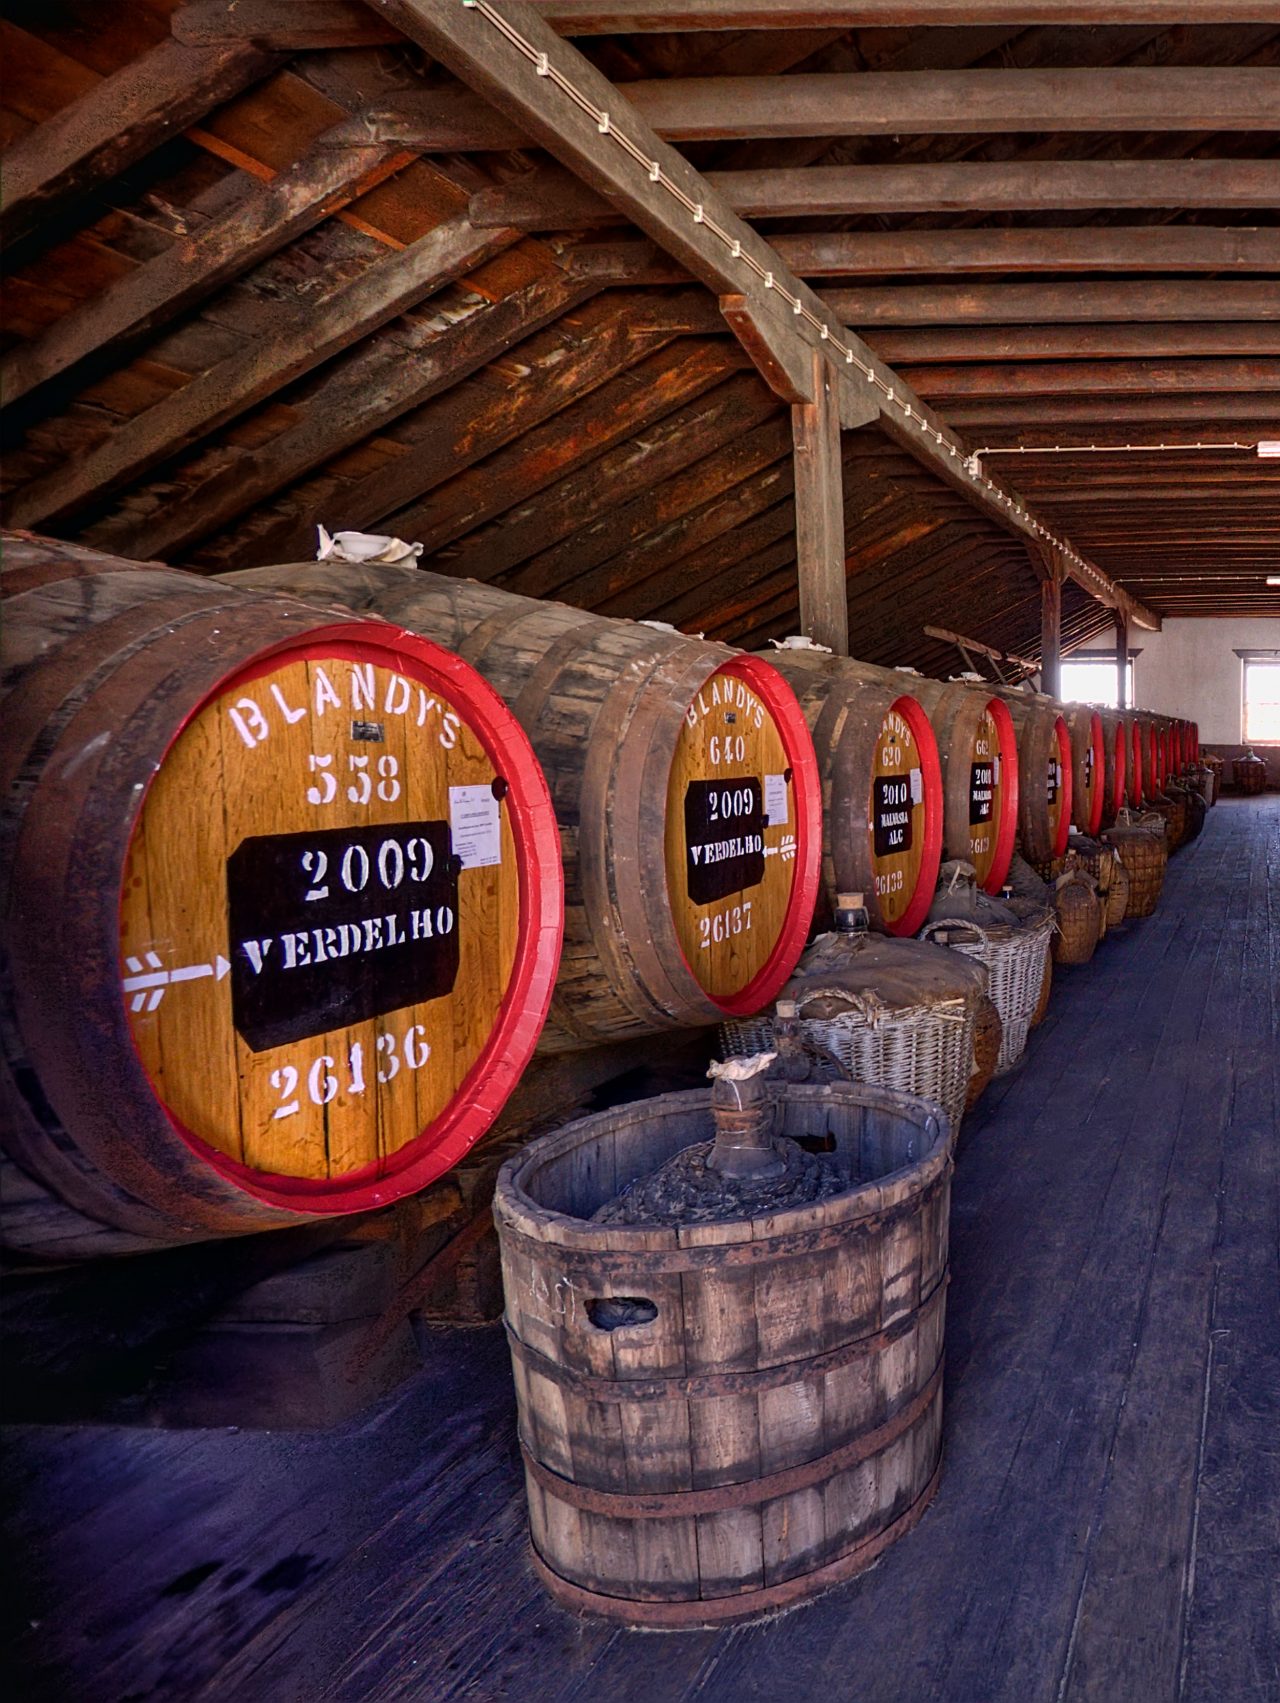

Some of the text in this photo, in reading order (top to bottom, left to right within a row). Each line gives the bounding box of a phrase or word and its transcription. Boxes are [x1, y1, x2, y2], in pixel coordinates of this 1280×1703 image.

[229, 663, 461, 748] BLANDY'S
[686, 678, 764, 728] BLANDY'S
[879, 712, 911, 747] ANDY'S
[710, 736, 745, 764] 640
[882, 746, 901, 766] 620
[307, 754, 401, 805] 558
[883, 783, 907, 806] 2010
[709, 788, 753, 821] 2009
[691, 835, 761, 865] VERDELHO
[888, 829, 904, 846] ALC
[302, 837, 435, 901] 2009
[875, 870, 903, 896] 26138
[242, 906, 454, 975] VERDELHO
[700, 902, 752, 948] 26137
[270, 1025, 431, 1120] 26136
